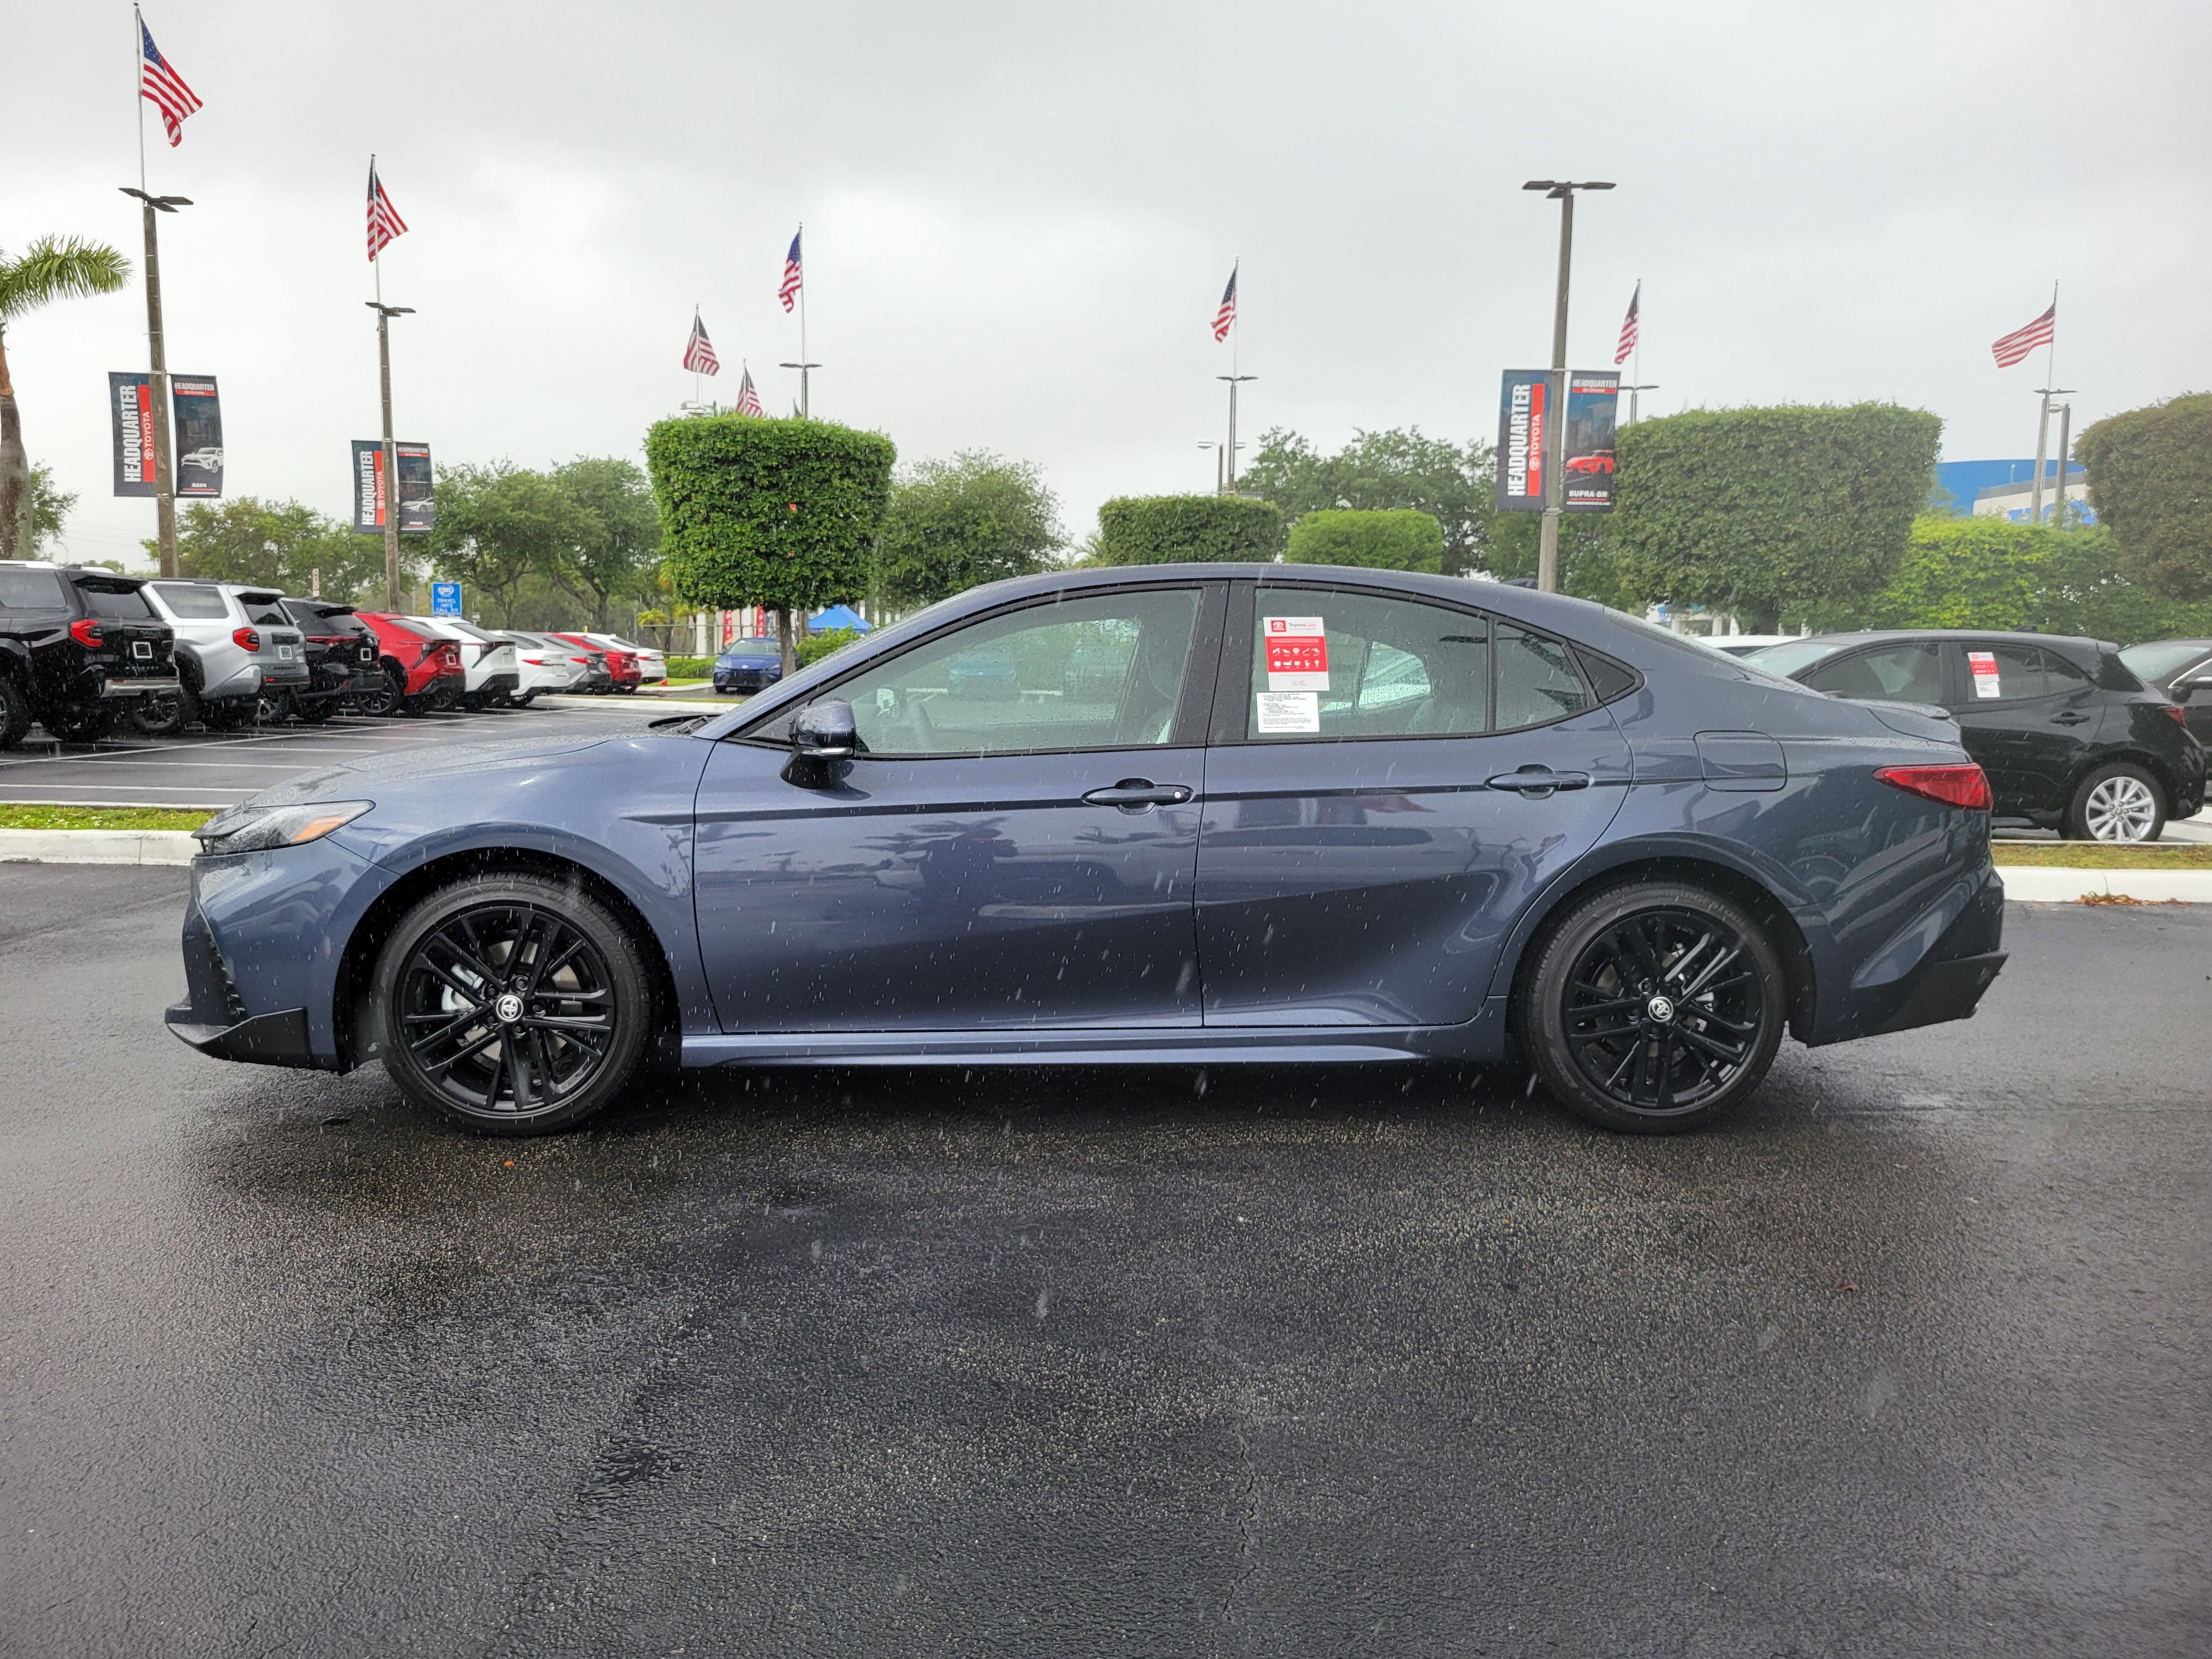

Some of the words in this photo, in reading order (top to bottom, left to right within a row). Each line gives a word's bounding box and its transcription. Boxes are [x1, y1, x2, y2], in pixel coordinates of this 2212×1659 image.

[174, 382, 215, 391] HEADQUARTER
[1572, 379, 1617, 387] HEADQUARTER
[120, 385, 142, 482] HEADQUARTER
[143, 411, 153, 448] TOYOTA
[1508, 384, 1529, 496] HEADQUARTER
[1530, 414, 1541, 456] TOYOTA
[359, 451, 377, 525] HEADQUARTER
